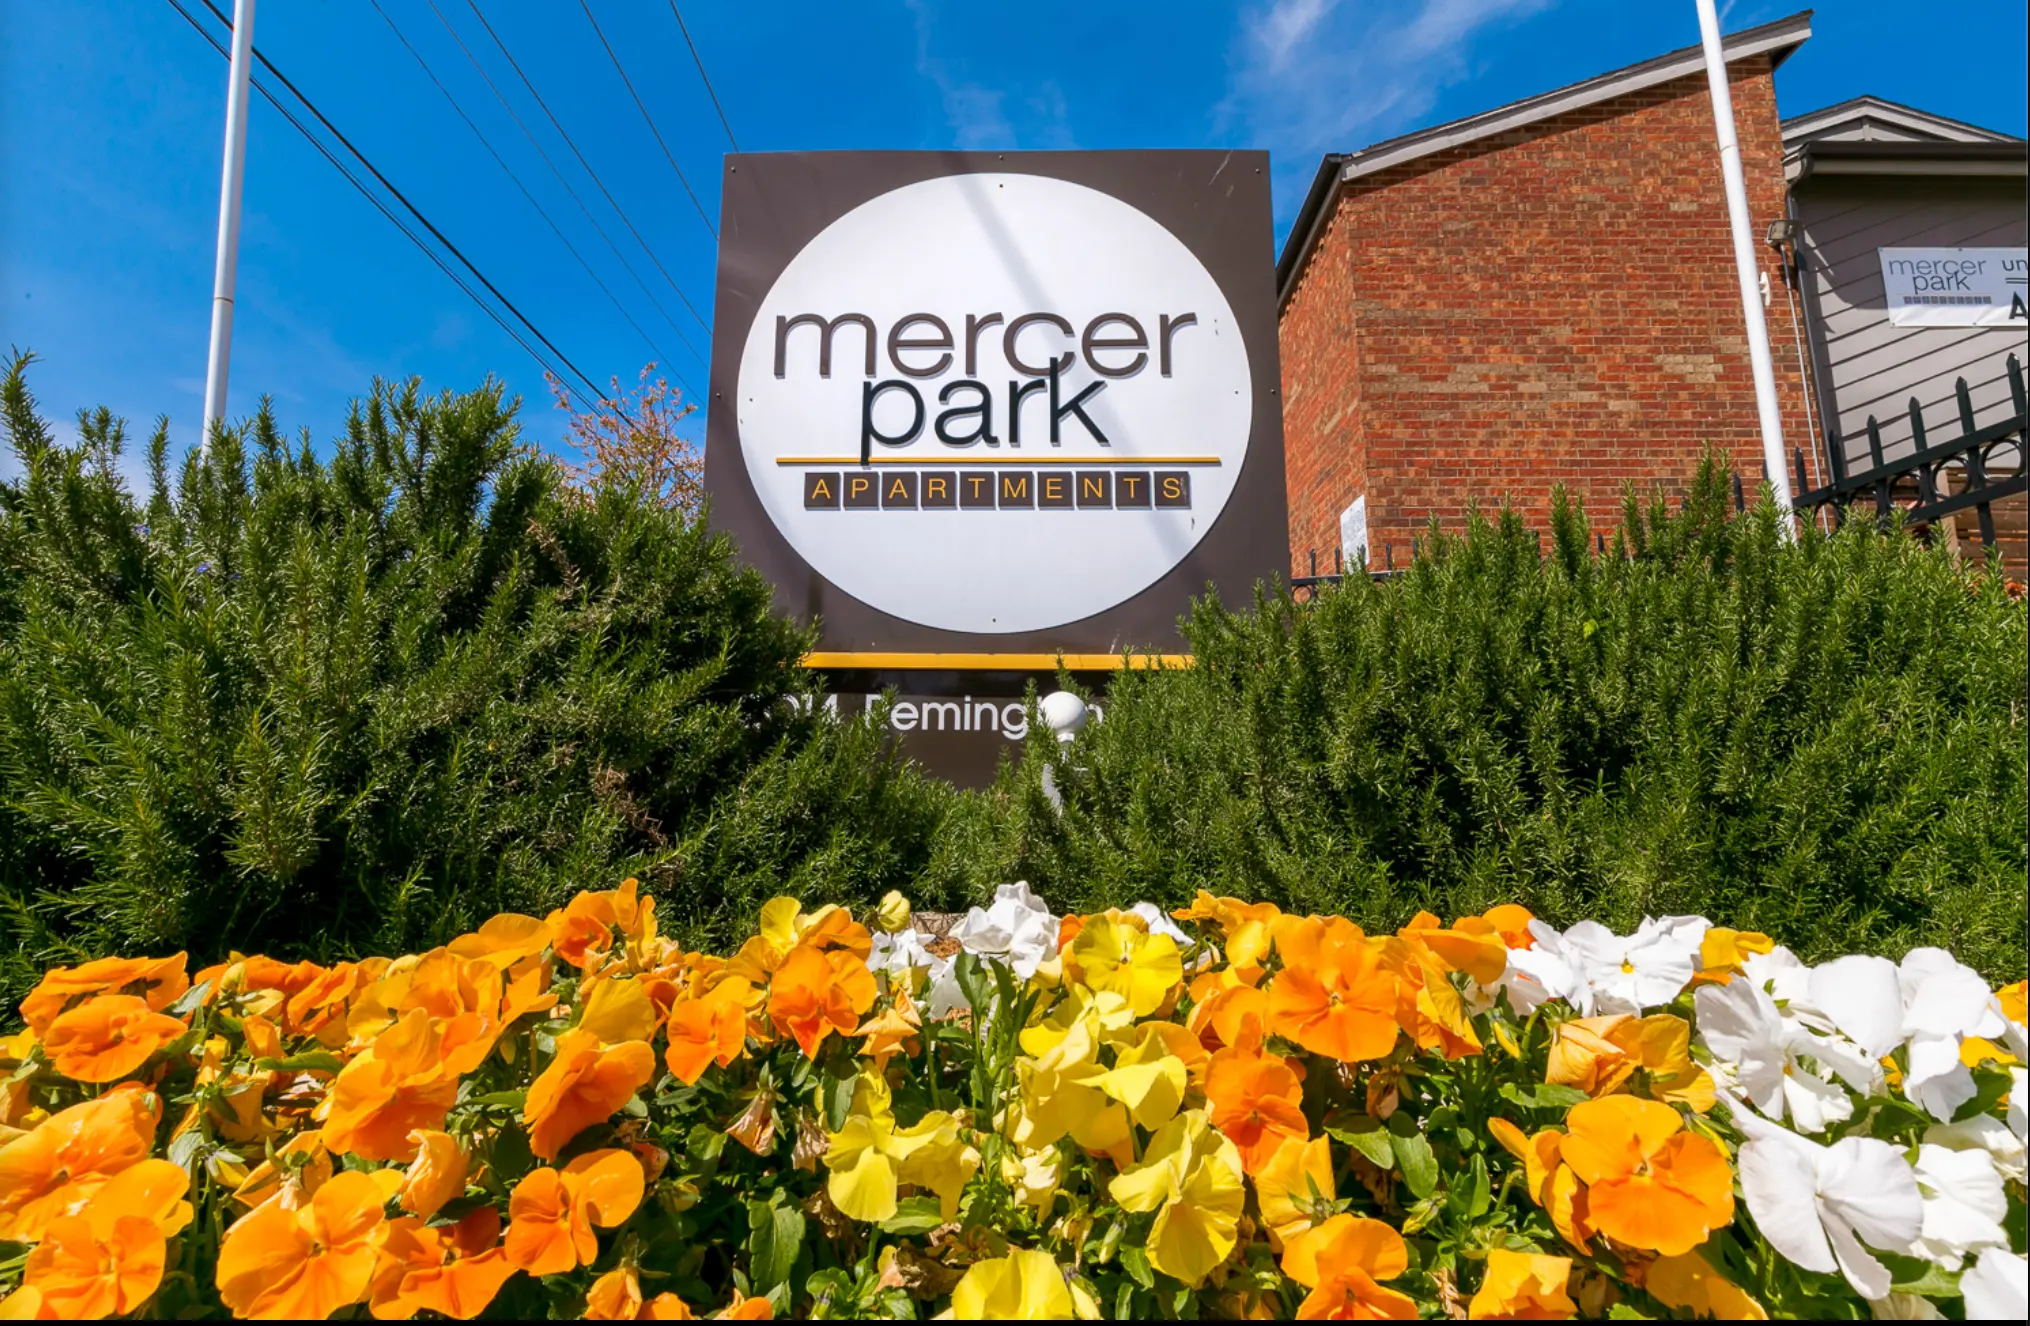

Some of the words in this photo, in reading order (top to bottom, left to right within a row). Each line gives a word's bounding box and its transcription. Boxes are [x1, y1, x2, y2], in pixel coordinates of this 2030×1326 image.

[1888, 259, 1987, 276] mercer
[1912, 270, 1971, 295] park
[774, 312, 1197, 378] mercer
[861, 357, 1110, 466] park
[811, 476, 1182, 500] APARTMENTS
